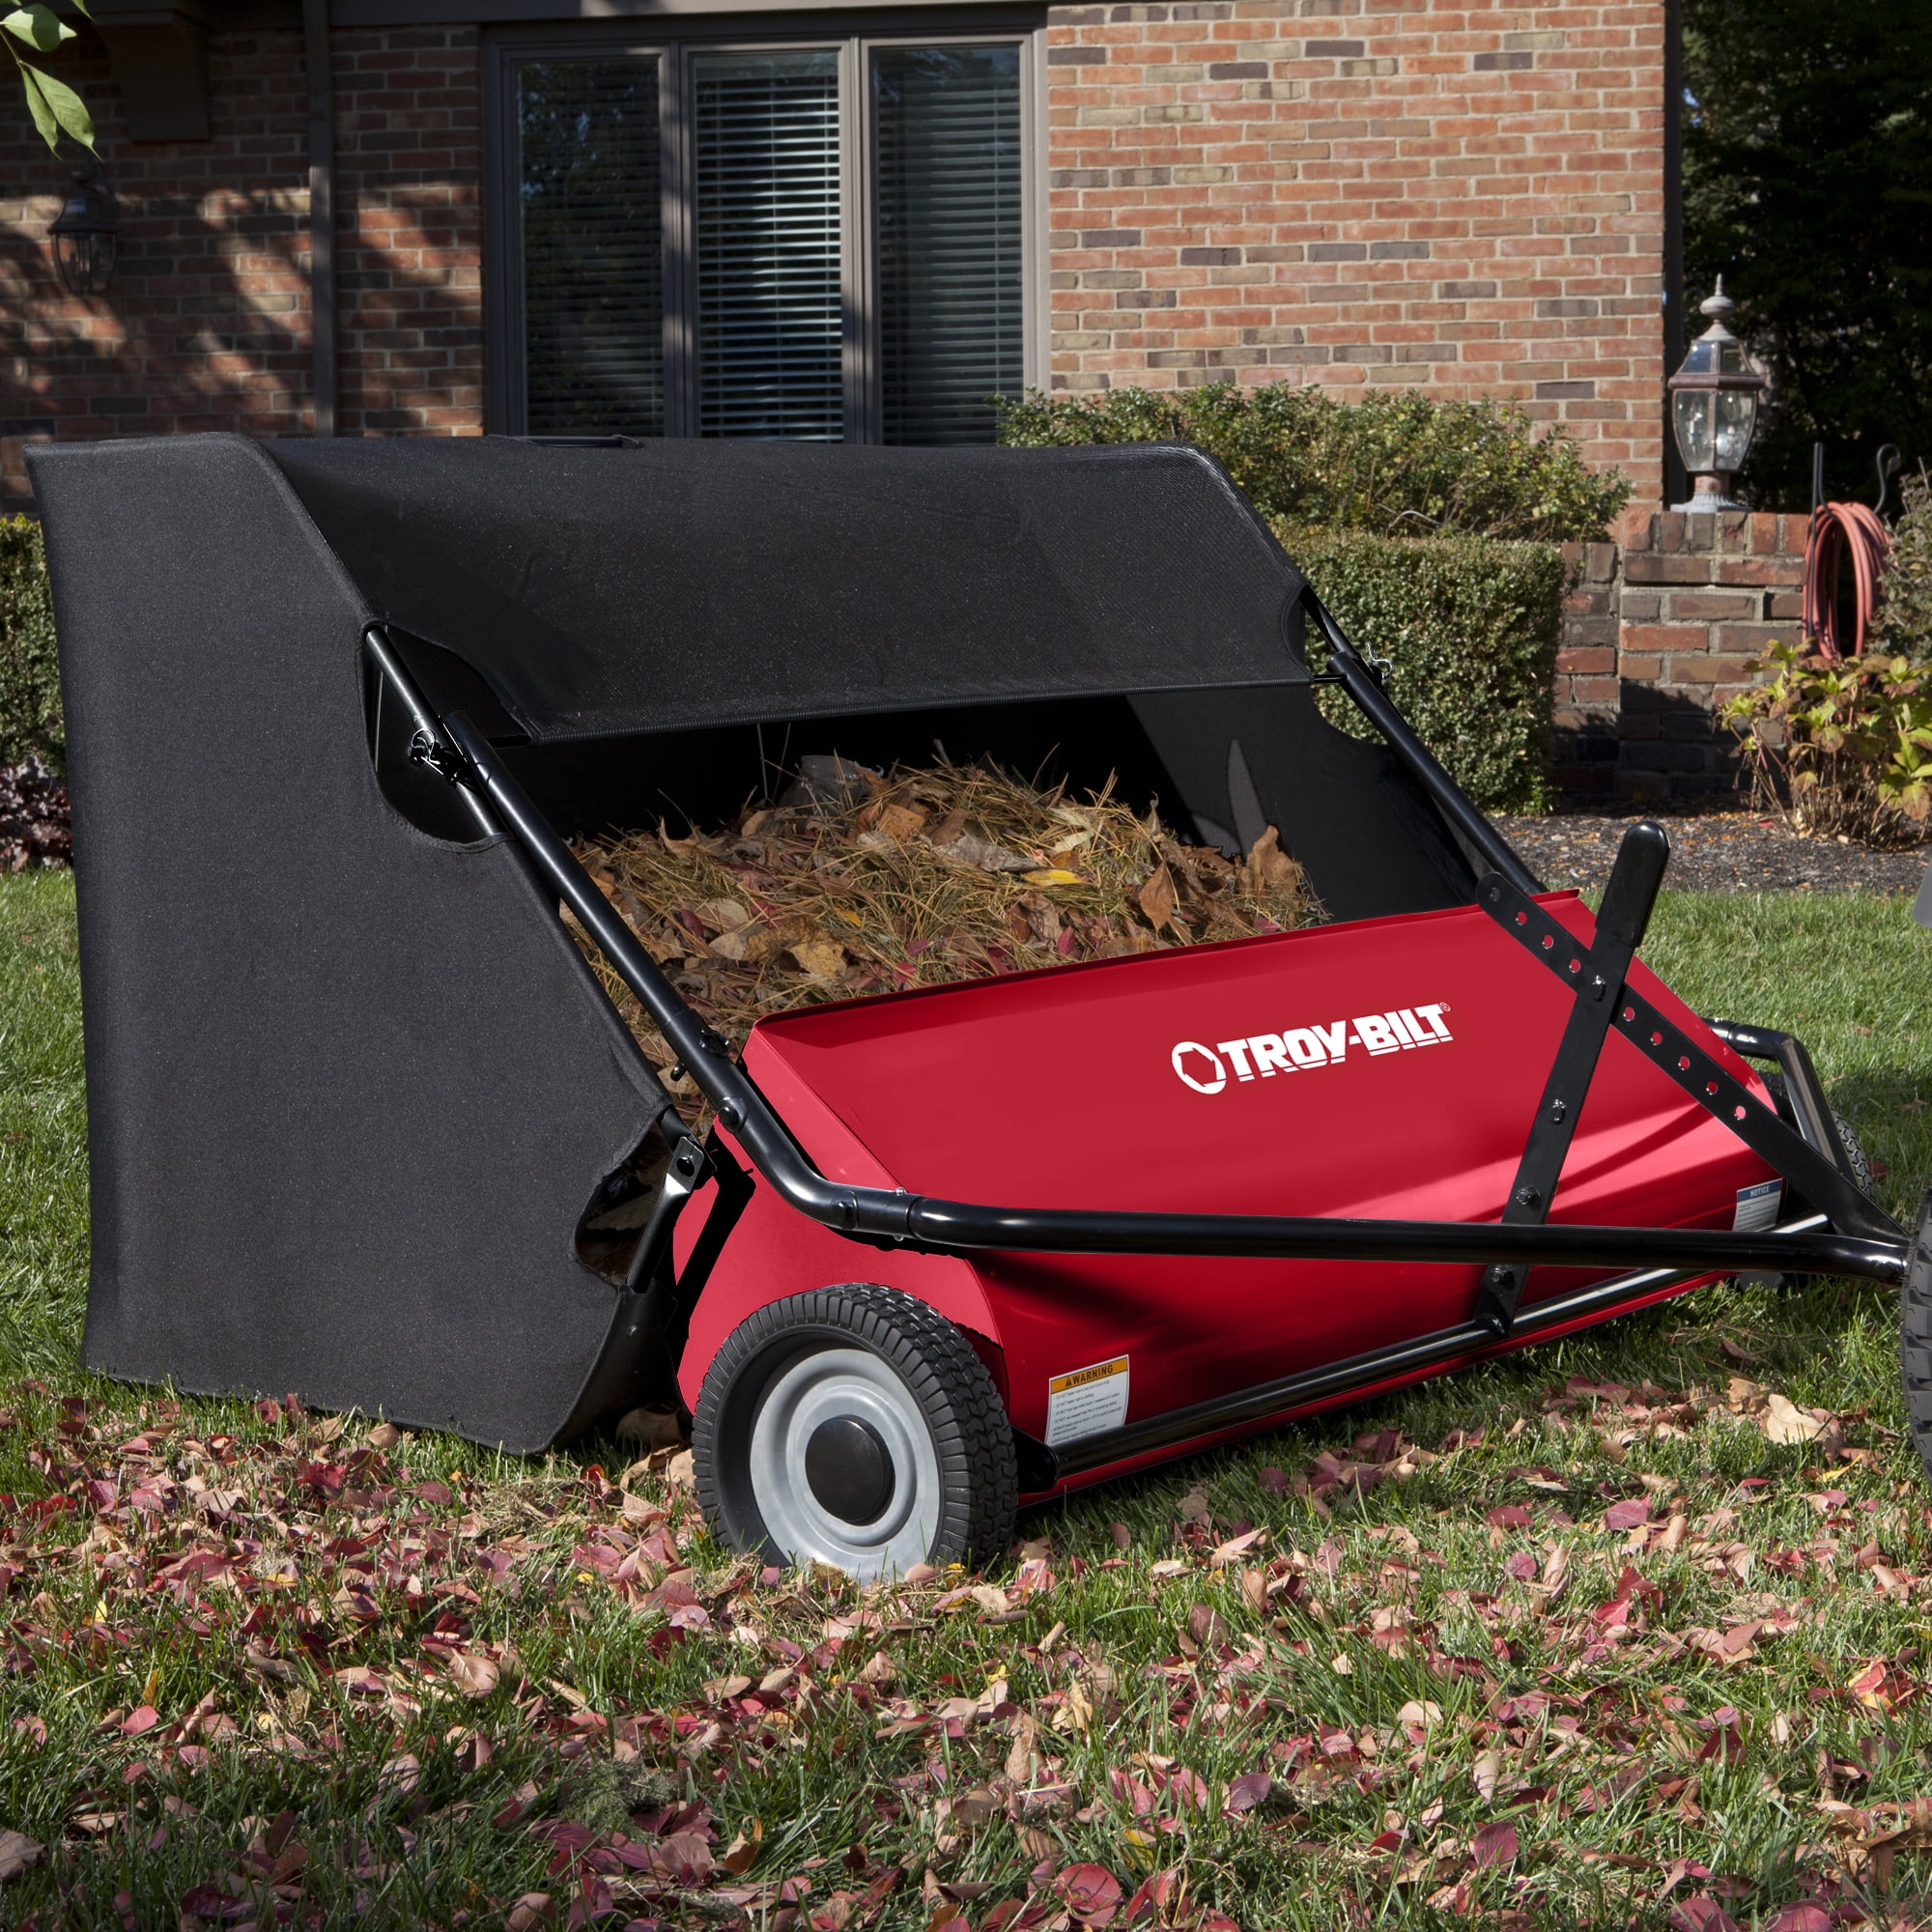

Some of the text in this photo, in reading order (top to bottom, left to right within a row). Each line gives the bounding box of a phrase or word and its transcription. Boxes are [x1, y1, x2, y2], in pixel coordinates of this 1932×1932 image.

[1216, 1003, 1454, 1082] TROY-BILT
[1750, 1185, 1770, 1197] NOTICE
[1072, 1364, 1114, 1383] WARNING
